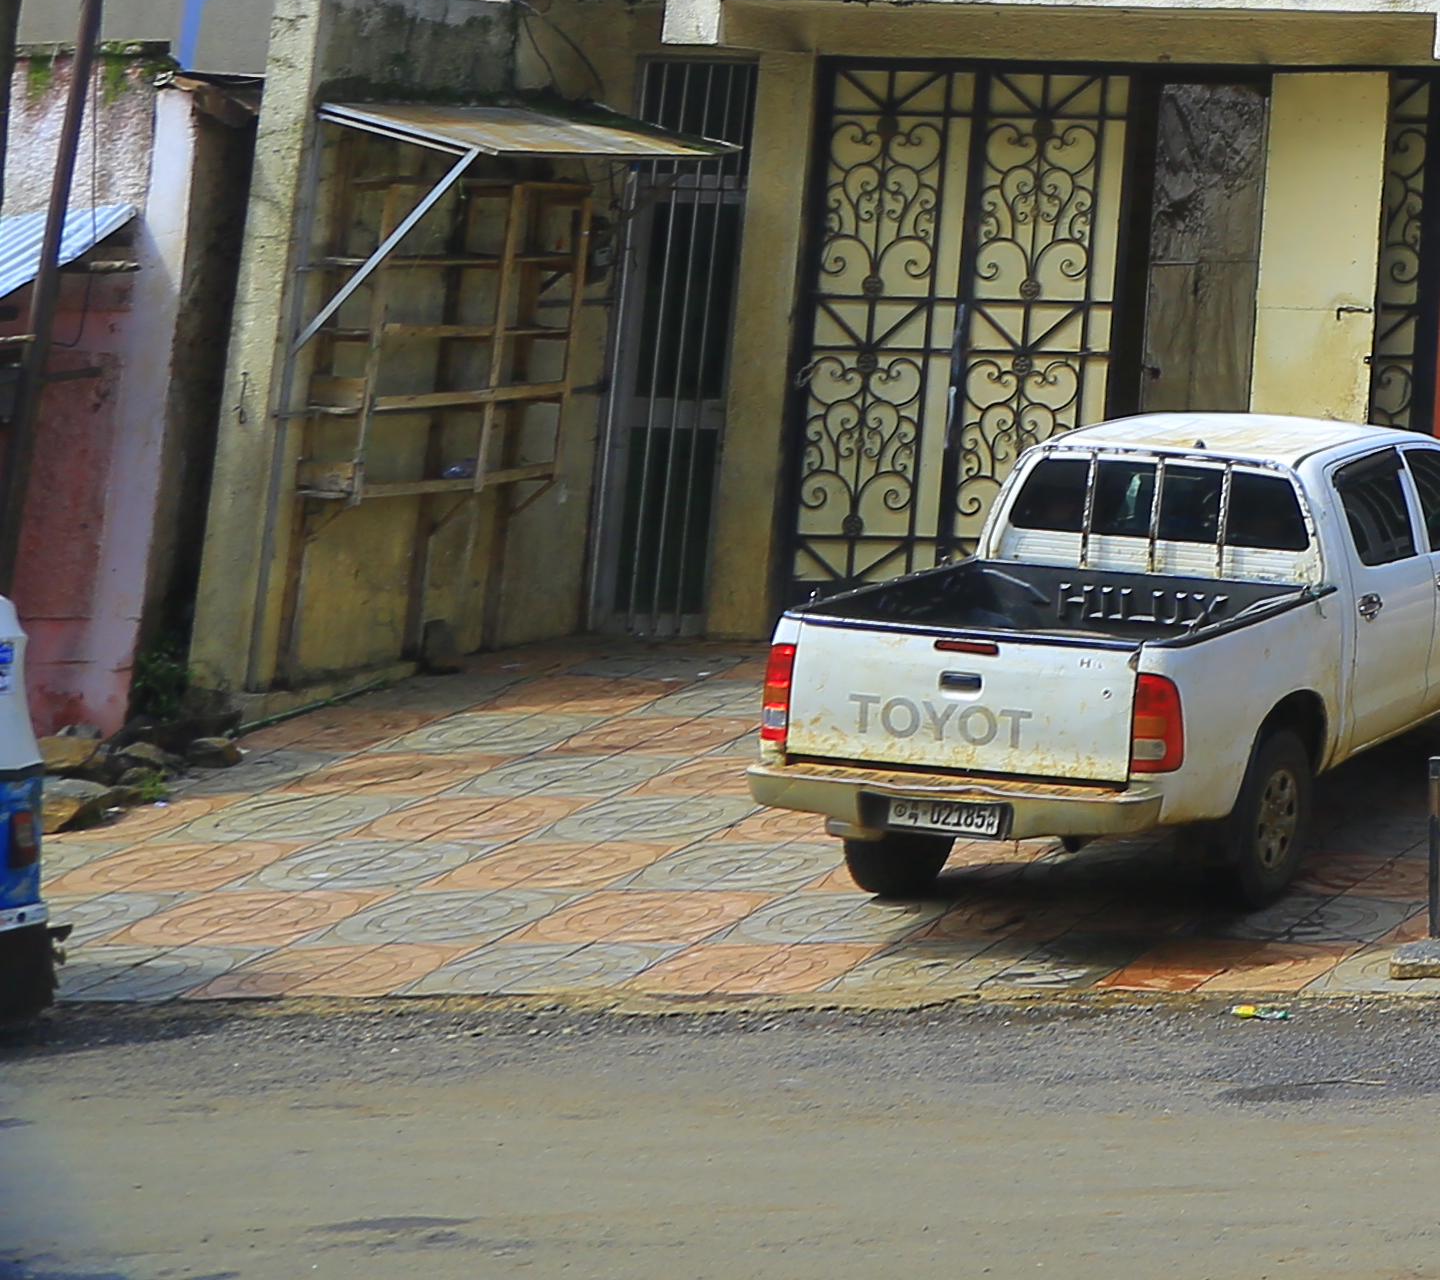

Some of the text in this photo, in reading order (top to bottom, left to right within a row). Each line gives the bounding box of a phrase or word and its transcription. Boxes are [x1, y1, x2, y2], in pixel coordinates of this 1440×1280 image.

[1057, 582, 1229, 626] HILUX
[849, 692, 1033, 750] TOYOT
[930, 802, 987, 829] 02185
